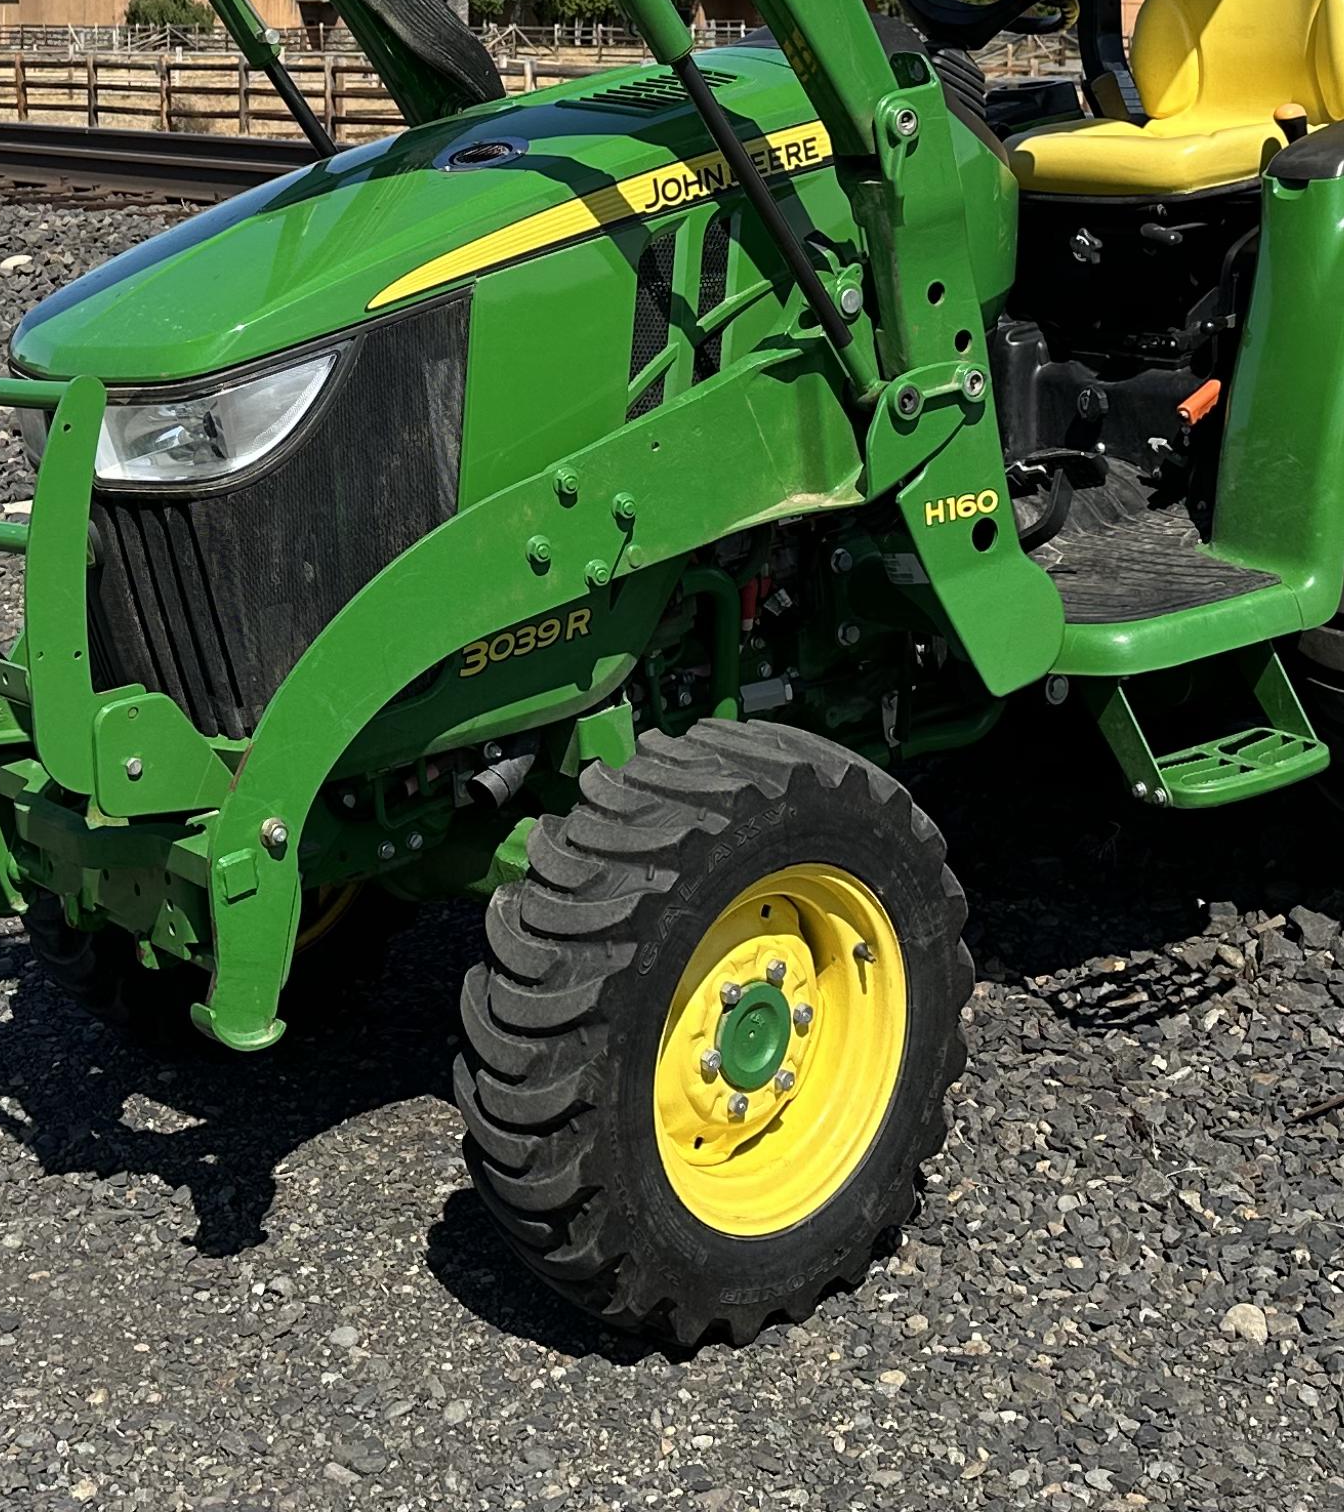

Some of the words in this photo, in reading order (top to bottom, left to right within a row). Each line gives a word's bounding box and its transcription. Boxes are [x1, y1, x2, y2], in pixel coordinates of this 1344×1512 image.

[645, 162, 724, 209] JOHN
[730, 136, 820, 184] EERE
[924, 489, 999, 527] H160
[638, 801, 787, 976] GALAXY
